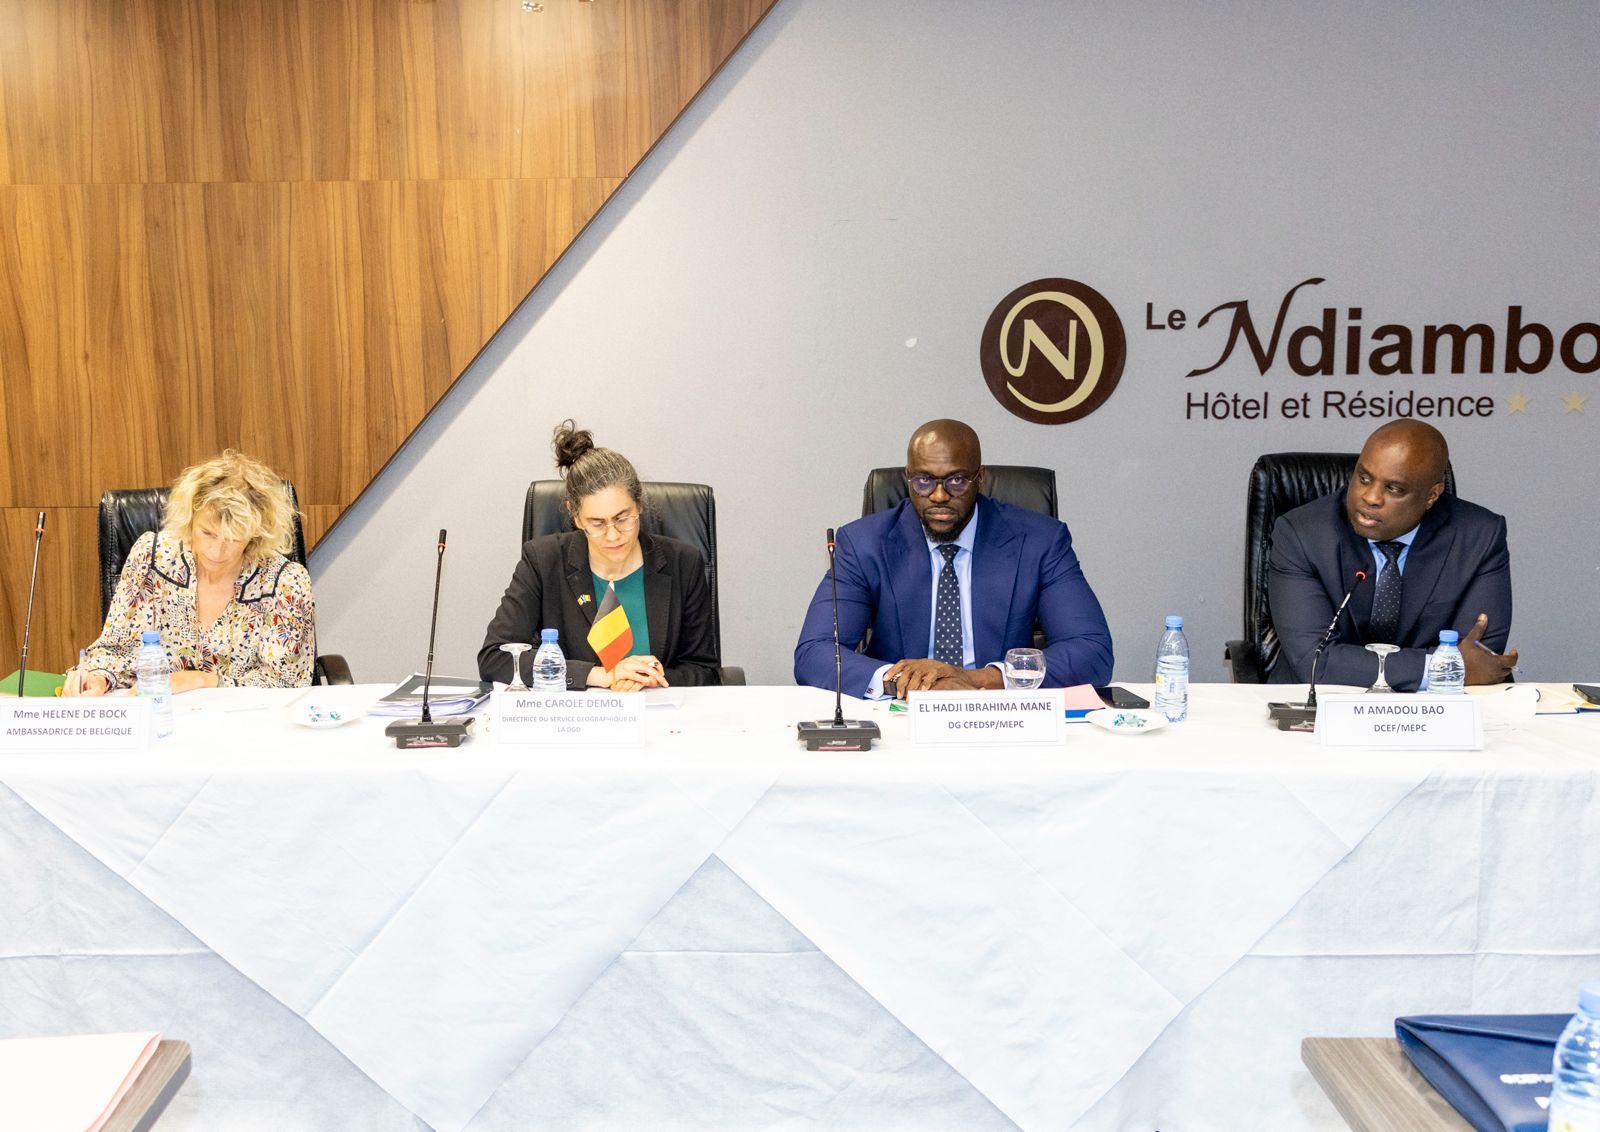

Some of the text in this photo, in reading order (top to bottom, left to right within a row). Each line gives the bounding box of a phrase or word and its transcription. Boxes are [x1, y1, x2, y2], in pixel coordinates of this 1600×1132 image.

[1145, 277, 1600, 378] Le Ndiambo
[1186, 390, 1495, 420] Hôtel et Résidence
[516, 698, 625, 709] Mme CAROLE DEMOL
[919, 701, 1052, 713] EL HADJI IBRAHIMA MANE
[13, 709, 128, 719] Mme HELENE DE BOCK
[1353, 705, 1445, 715] M AMADOU BAO
[948, 719, 1025, 730] DG CFEDSP/MEPC
[1374, 723, 1427, 734] DCEF/MEPC
[5, 727, 133, 737] AMBASSADRICE DE BELGIQUE
